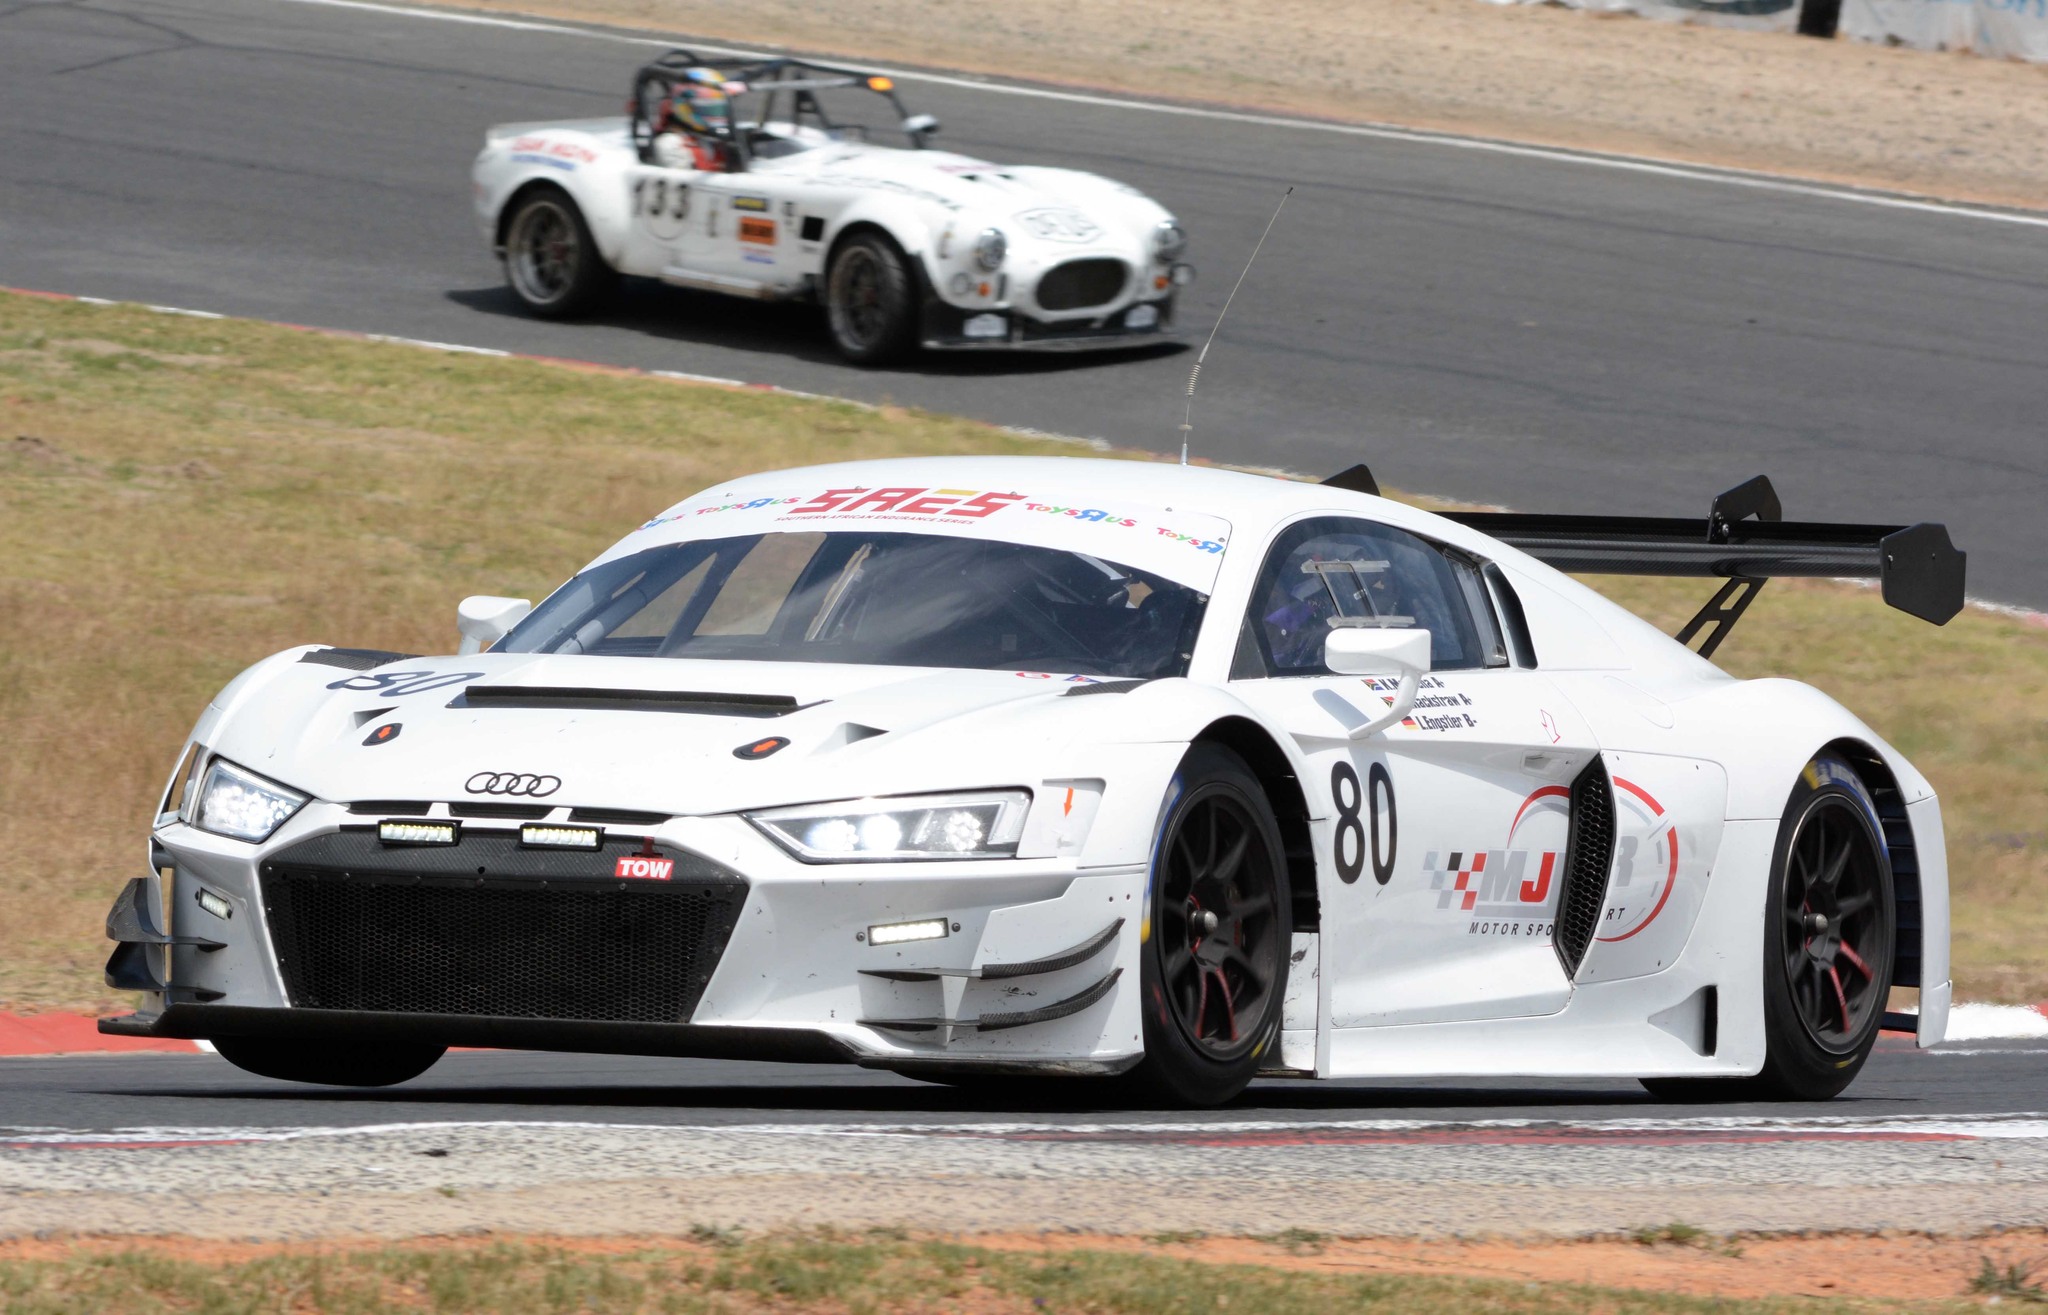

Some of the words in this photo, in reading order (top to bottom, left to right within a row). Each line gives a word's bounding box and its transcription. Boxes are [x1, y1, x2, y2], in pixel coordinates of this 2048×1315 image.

[631, 179, 691, 220] 133
[788, 488, 1029, 517] SAES
[774, 514, 827, 522] SOUTHERN
[326, 671, 486, 697] 80
[1415, 714, 1463, 732] L.Engstler
[1331, 760, 1398, 886] 80
[619, 859, 672, 879] TOW
[1468, 921, 1519, 935] MOTOR
